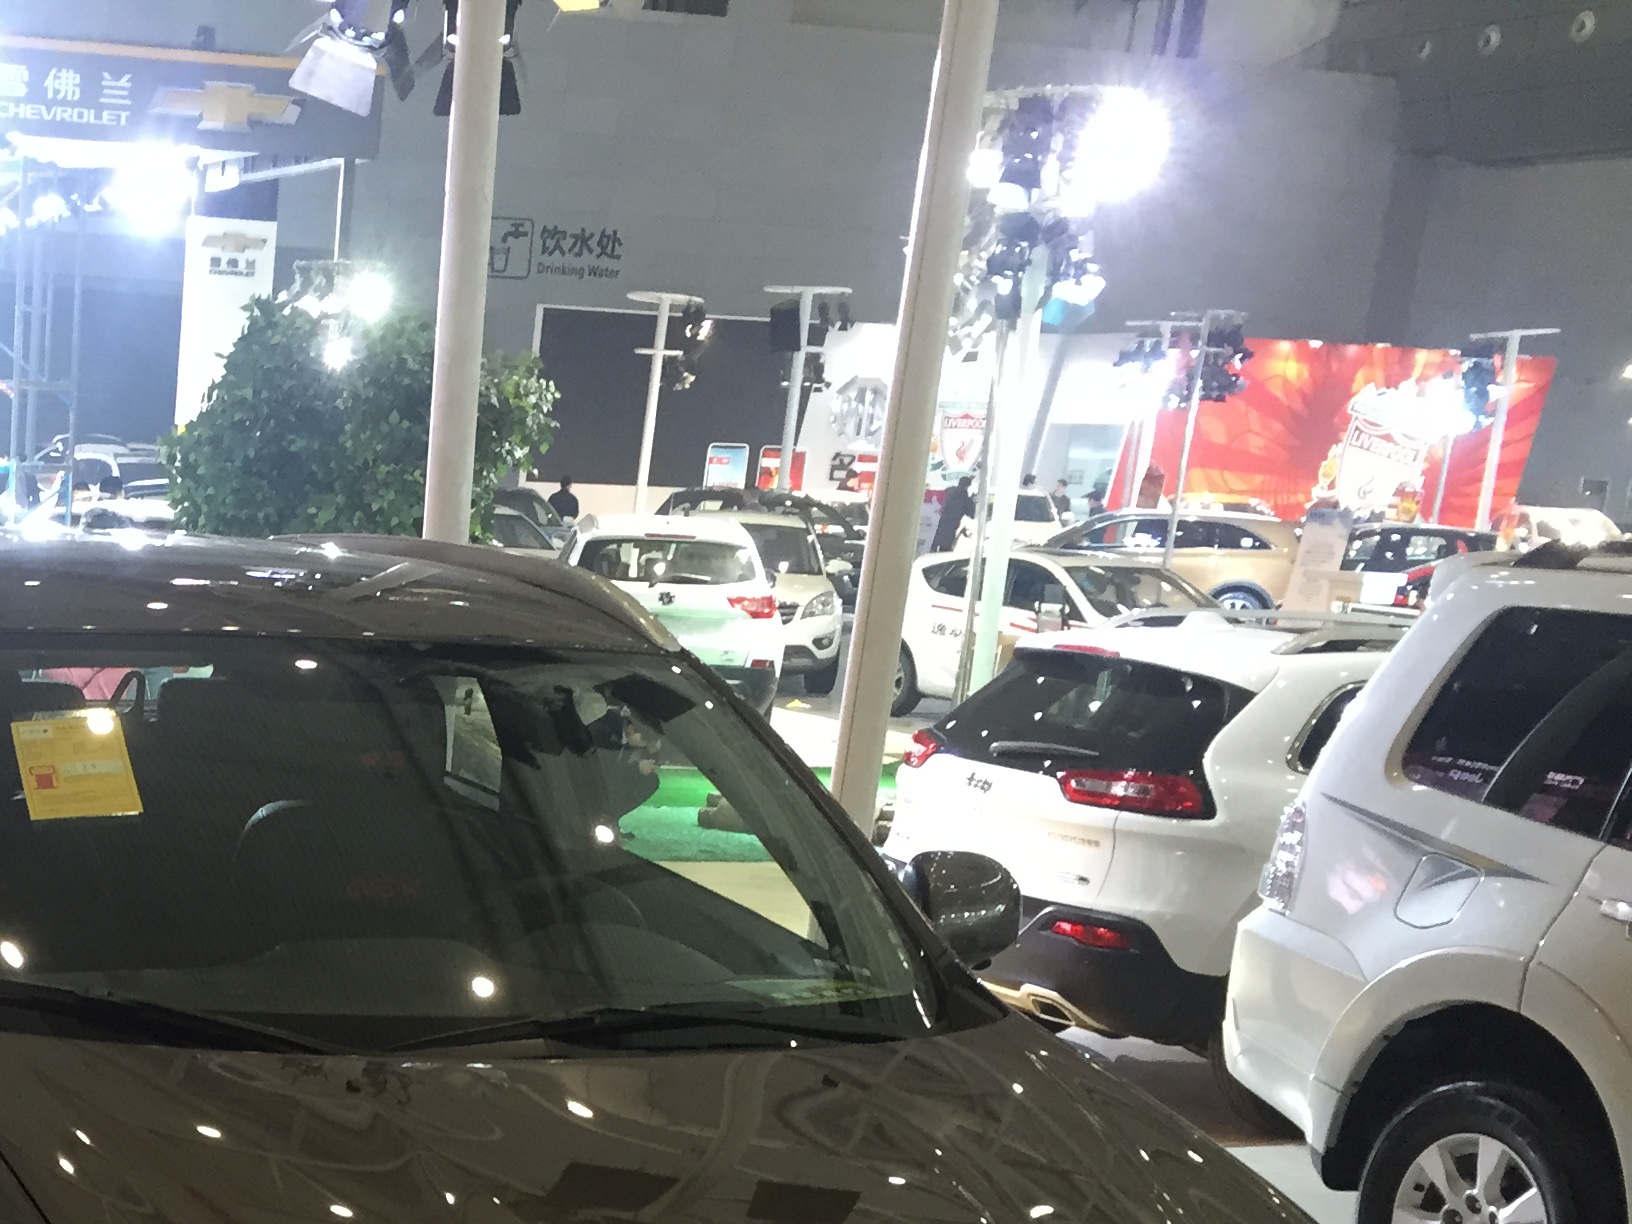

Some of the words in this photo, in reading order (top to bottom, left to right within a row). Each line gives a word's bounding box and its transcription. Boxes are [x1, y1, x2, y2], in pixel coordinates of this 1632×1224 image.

[539, 224, 623, 260] 饮水处
[536, 261, 586, 280] Drinking
[587, 264, 620, 279] Water
